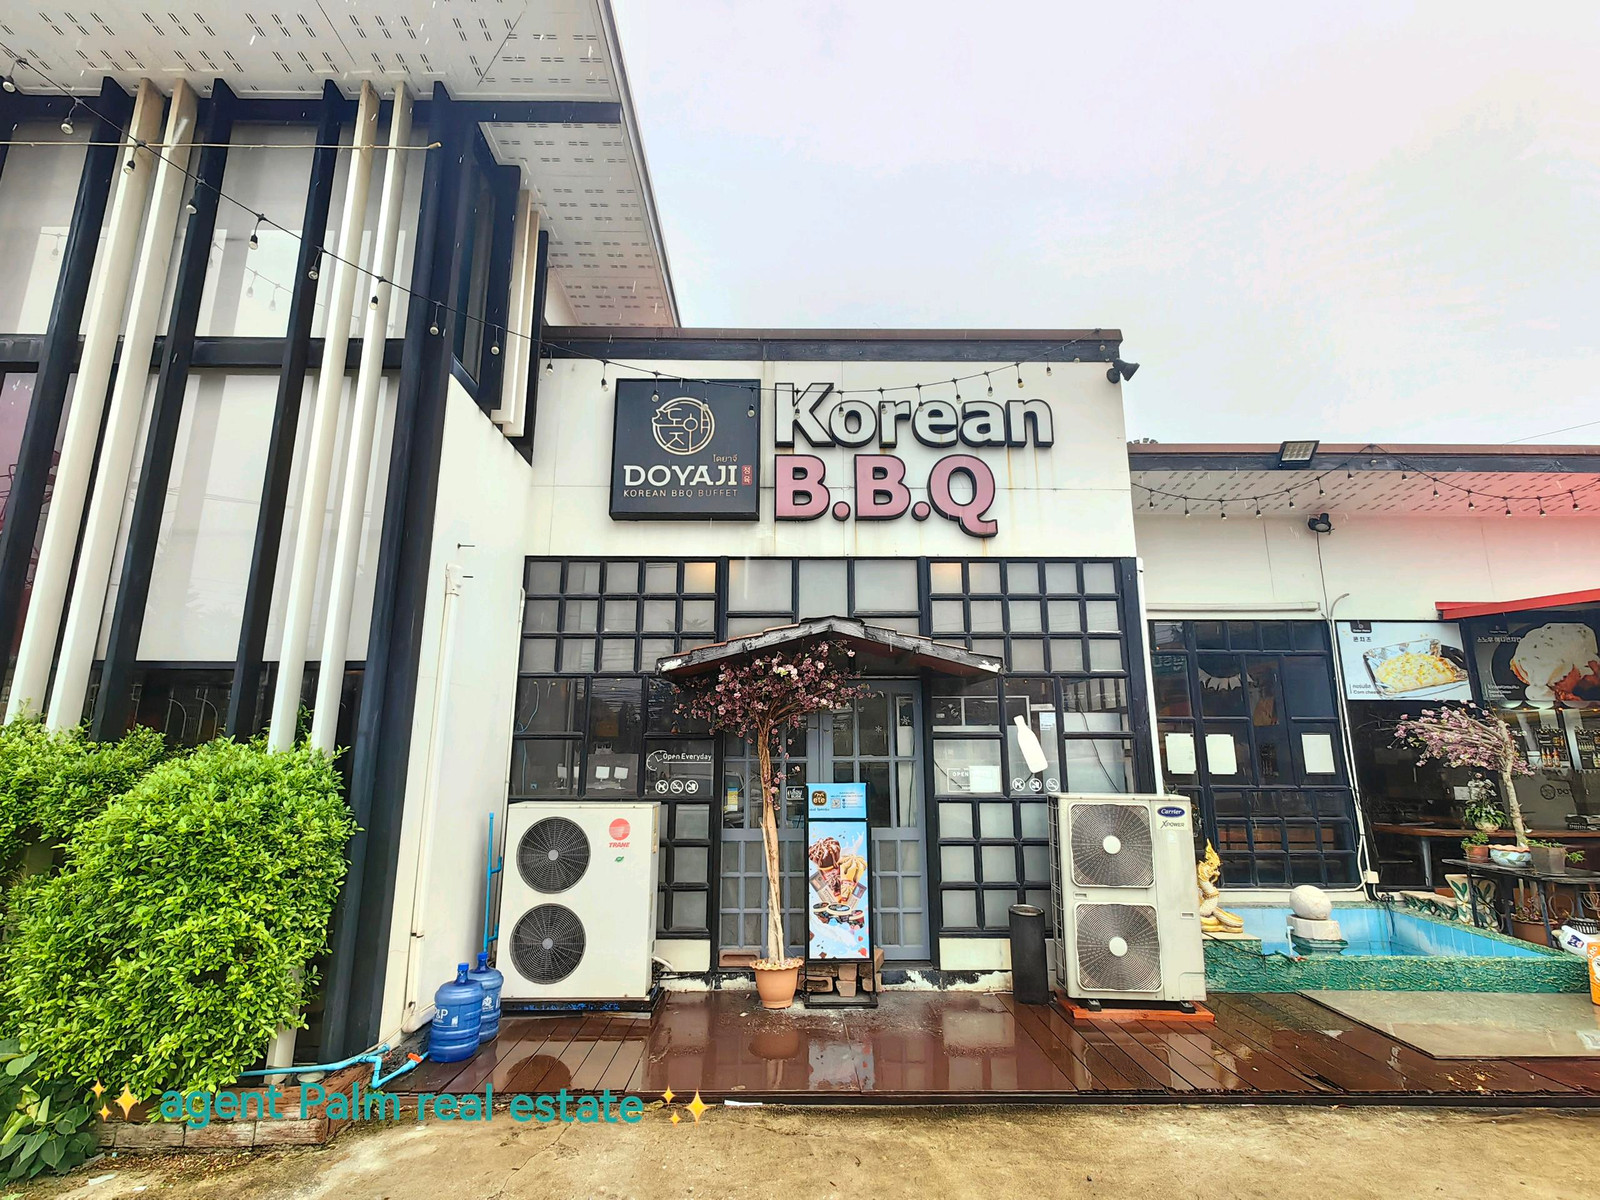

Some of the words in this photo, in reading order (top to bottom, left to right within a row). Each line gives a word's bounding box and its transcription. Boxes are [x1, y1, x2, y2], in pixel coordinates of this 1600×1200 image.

[774, 381, 1055, 449] Korean
[623, 465, 738, 487] DOYAJI
[623, 489, 666, 498] KOREAN
[671, 489, 693, 498] BBQ
[698, 489, 738, 497] BUFFET
[774, 453, 998, 538] B.B.Q
[662, 753, 680, 761] Open
[681, 752, 712, 761] Everyday
